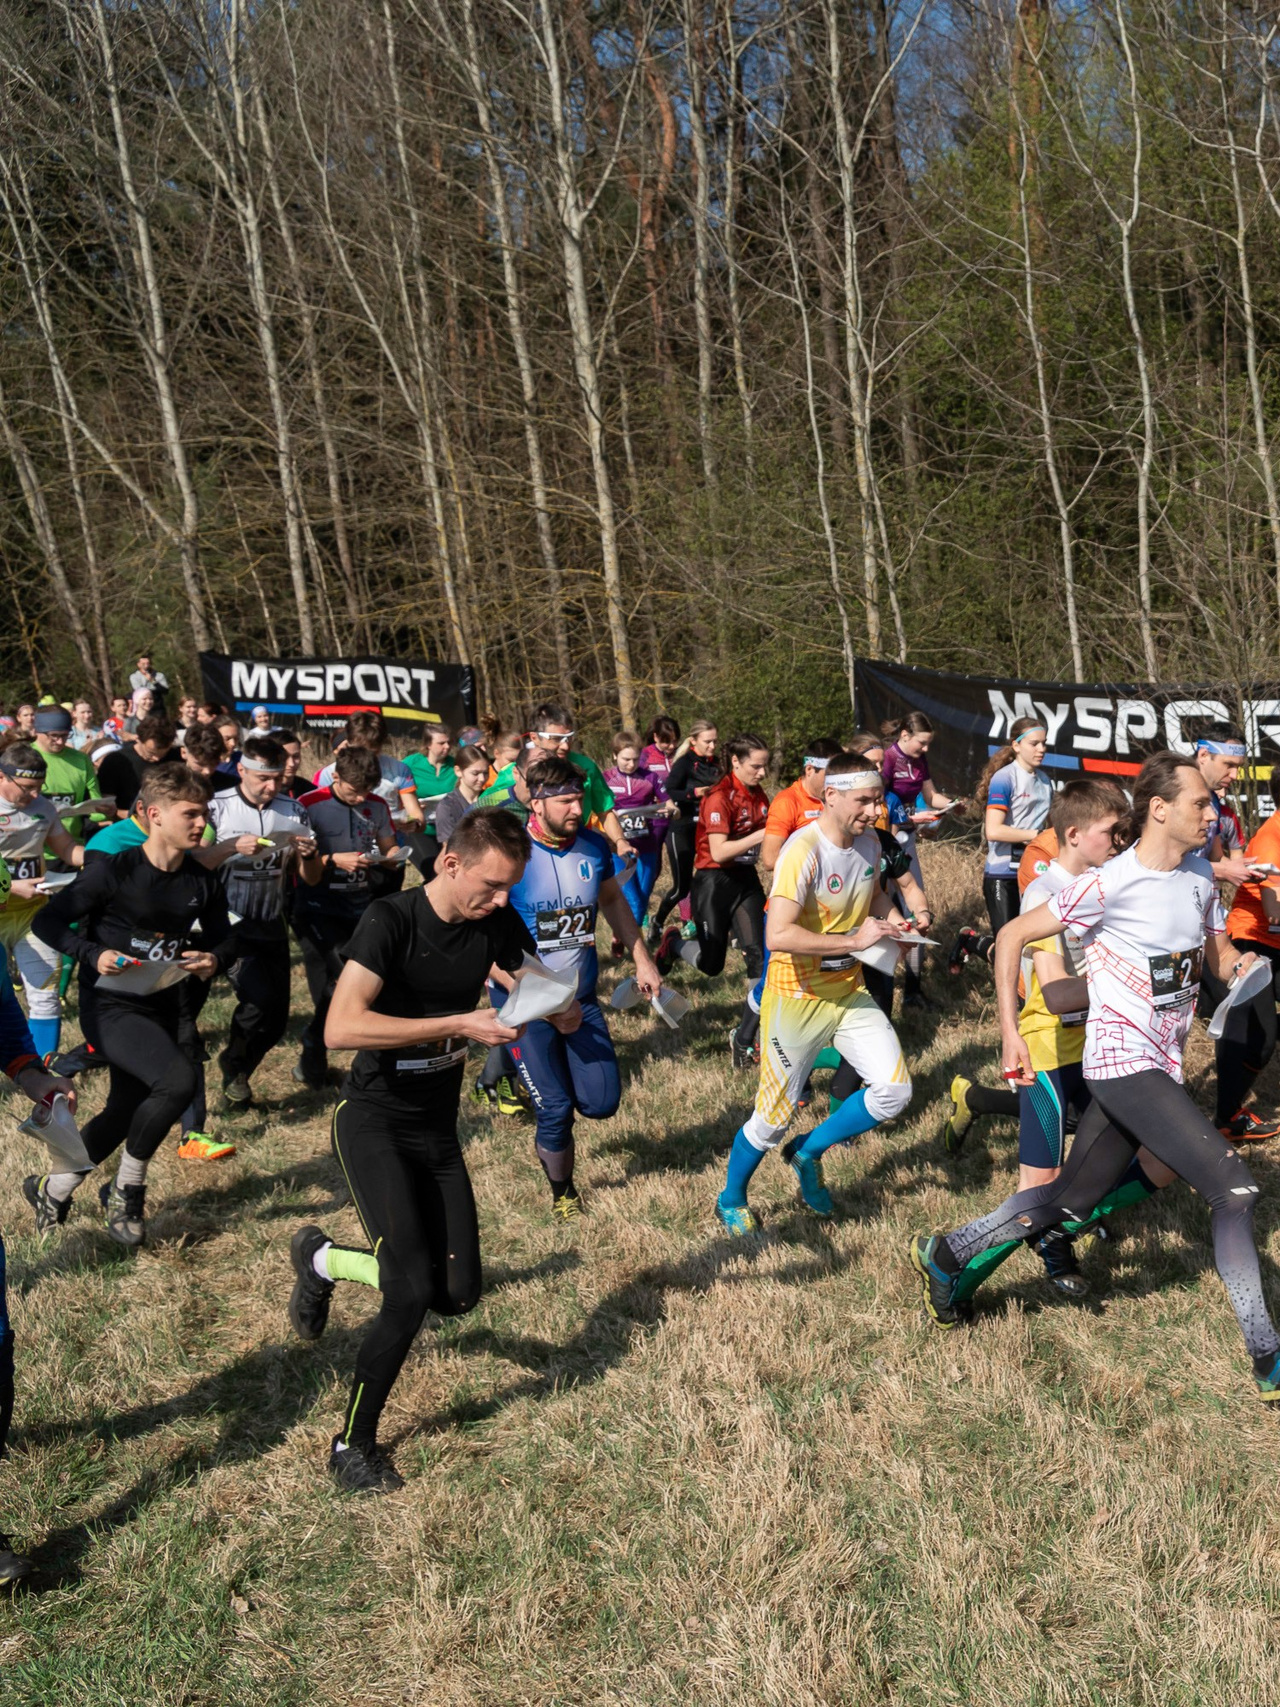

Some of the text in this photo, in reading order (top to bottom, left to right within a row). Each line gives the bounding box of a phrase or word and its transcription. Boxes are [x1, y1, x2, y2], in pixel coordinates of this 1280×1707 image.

[17, 861, 36, 879] 61
[558, 913, 587, 939] 22
[148, 939, 179, 962] 63
[1181, 957, 1192, 988] 2
[771, 1037, 792, 1069] TRIMTEX
[519, 1062, 545, 1110] TRIMTE
